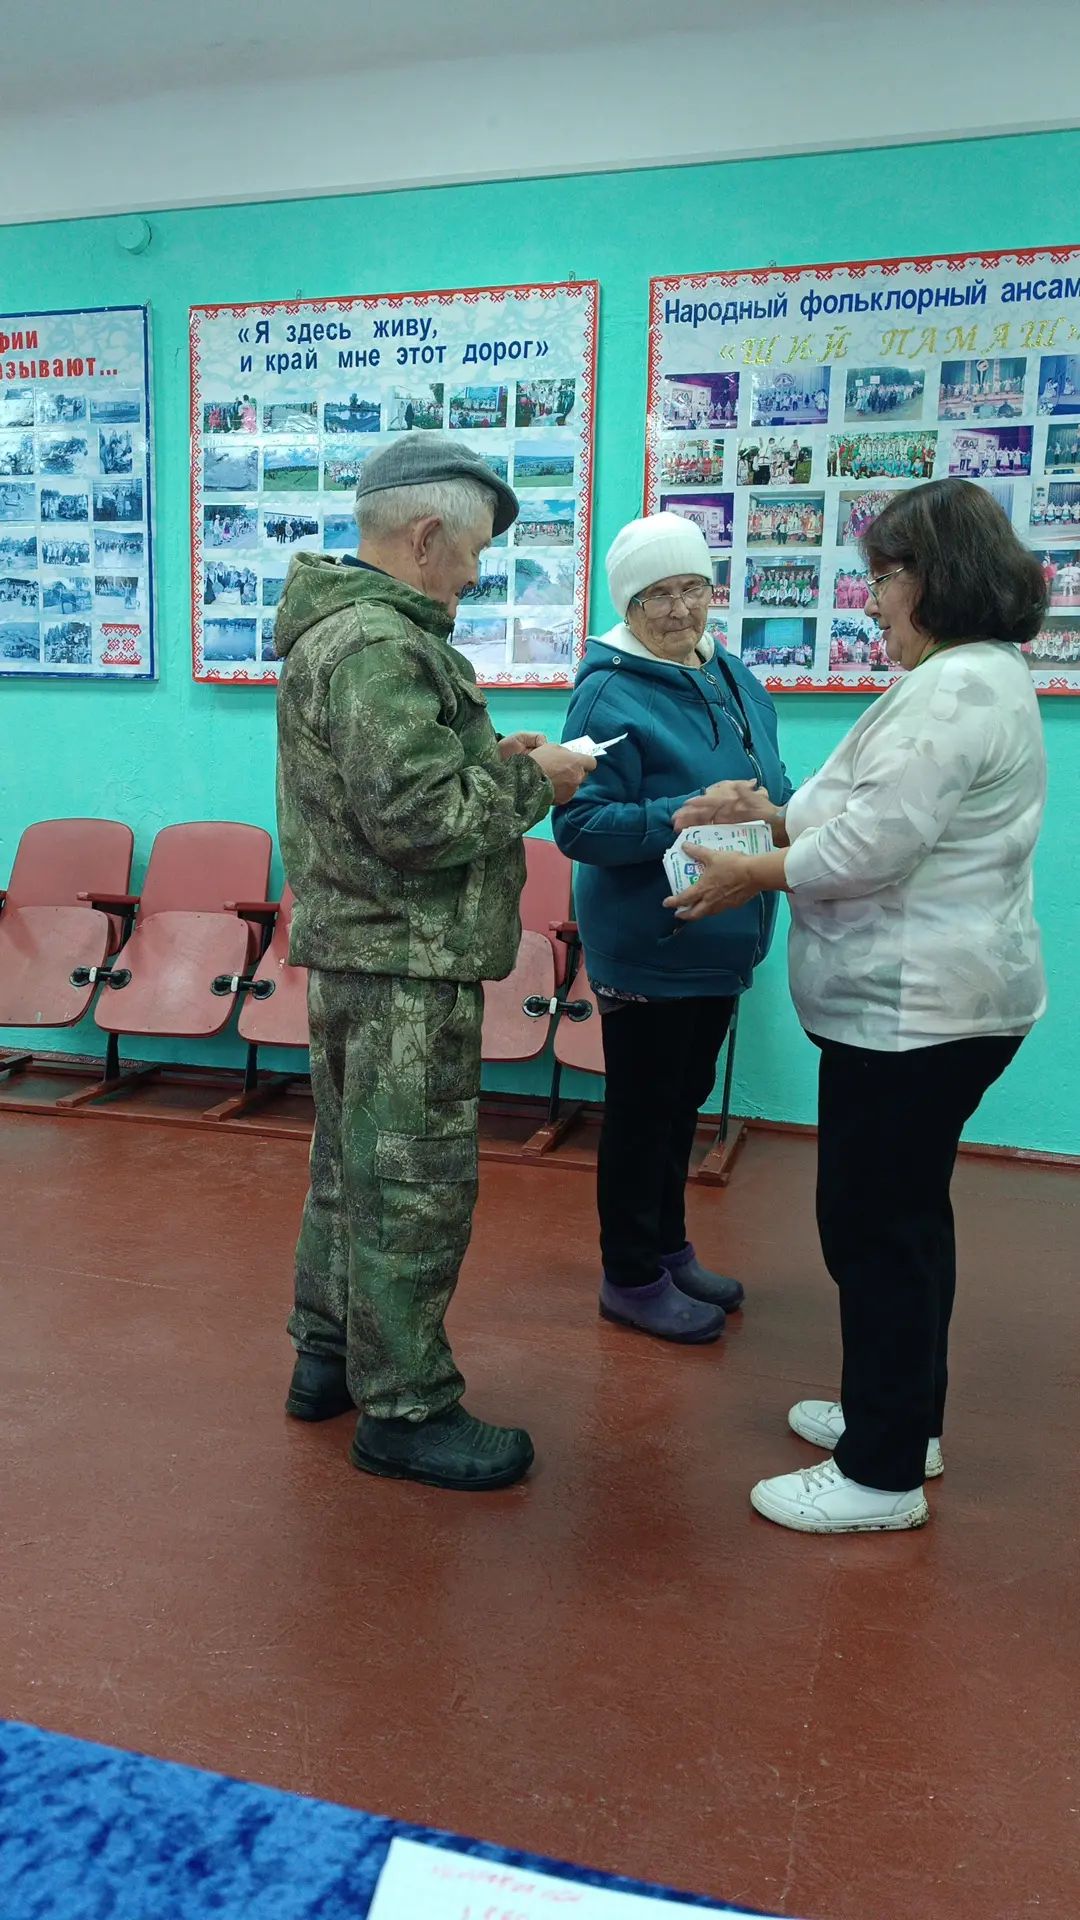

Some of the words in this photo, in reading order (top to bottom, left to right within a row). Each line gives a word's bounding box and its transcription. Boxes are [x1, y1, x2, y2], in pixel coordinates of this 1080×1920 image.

[664, 291, 788, 328] Народный
[800, 278, 987, 322] фольклорный
[286, 322, 352, 344] здесь
[373, 317, 438, 341] живу,
[0, 357, 118, 379] зывают...
[240, 354, 252, 373] и
[266, 348, 318, 374] край
[338, 348, 381, 369] мне
[396, 345, 447, 366] этот
[462, 340, 549, 366] дорог»
